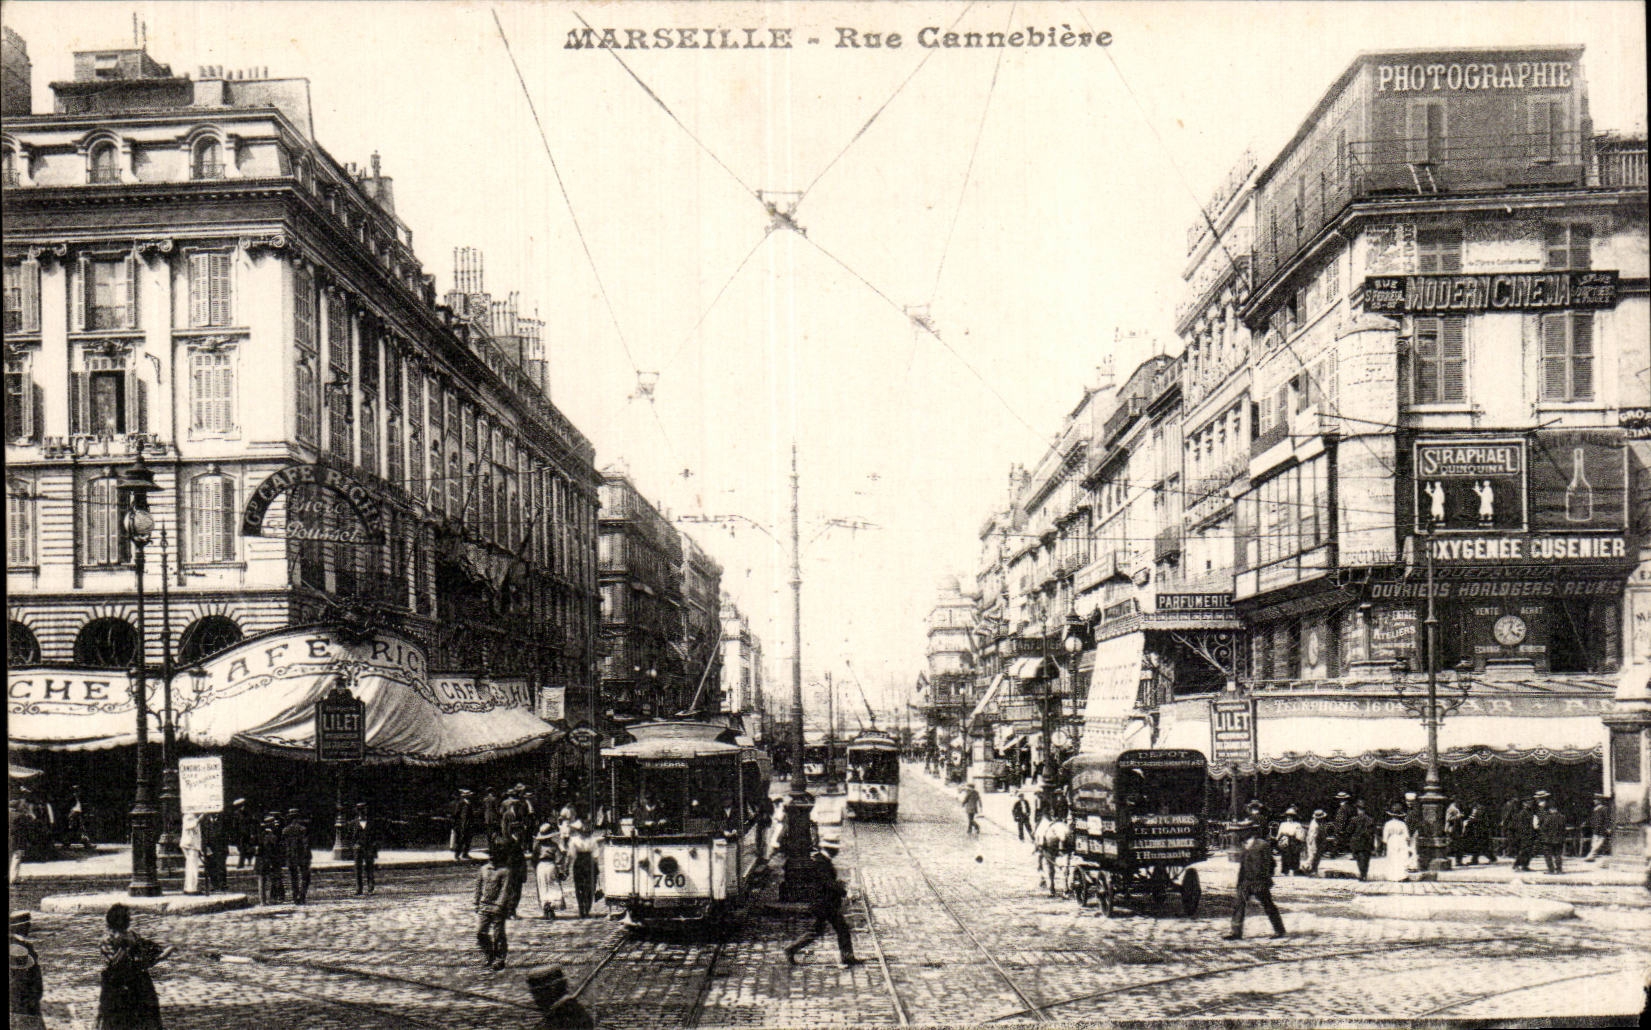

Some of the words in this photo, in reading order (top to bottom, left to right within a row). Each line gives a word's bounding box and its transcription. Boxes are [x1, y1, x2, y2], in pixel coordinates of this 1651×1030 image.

[1379, 61, 1572, 91] PHOTOGRAPHIE
[1406, 275, 1491, 311] MODERN
[1492, 273, 1571, 308] CINEMA
[1530, 538, 1626, 559] CUSENIER
[1459, 581, 1552, 597] HORLOGERS
[1159, 594, 1231, 609] PARFUMERIE
[323, 714, 360, 731] LILET
[1214, 712, 1249, 731] LILET
[1151, 826, 1191, 835] FIGARO
[653, 874, 686, 889] 760
